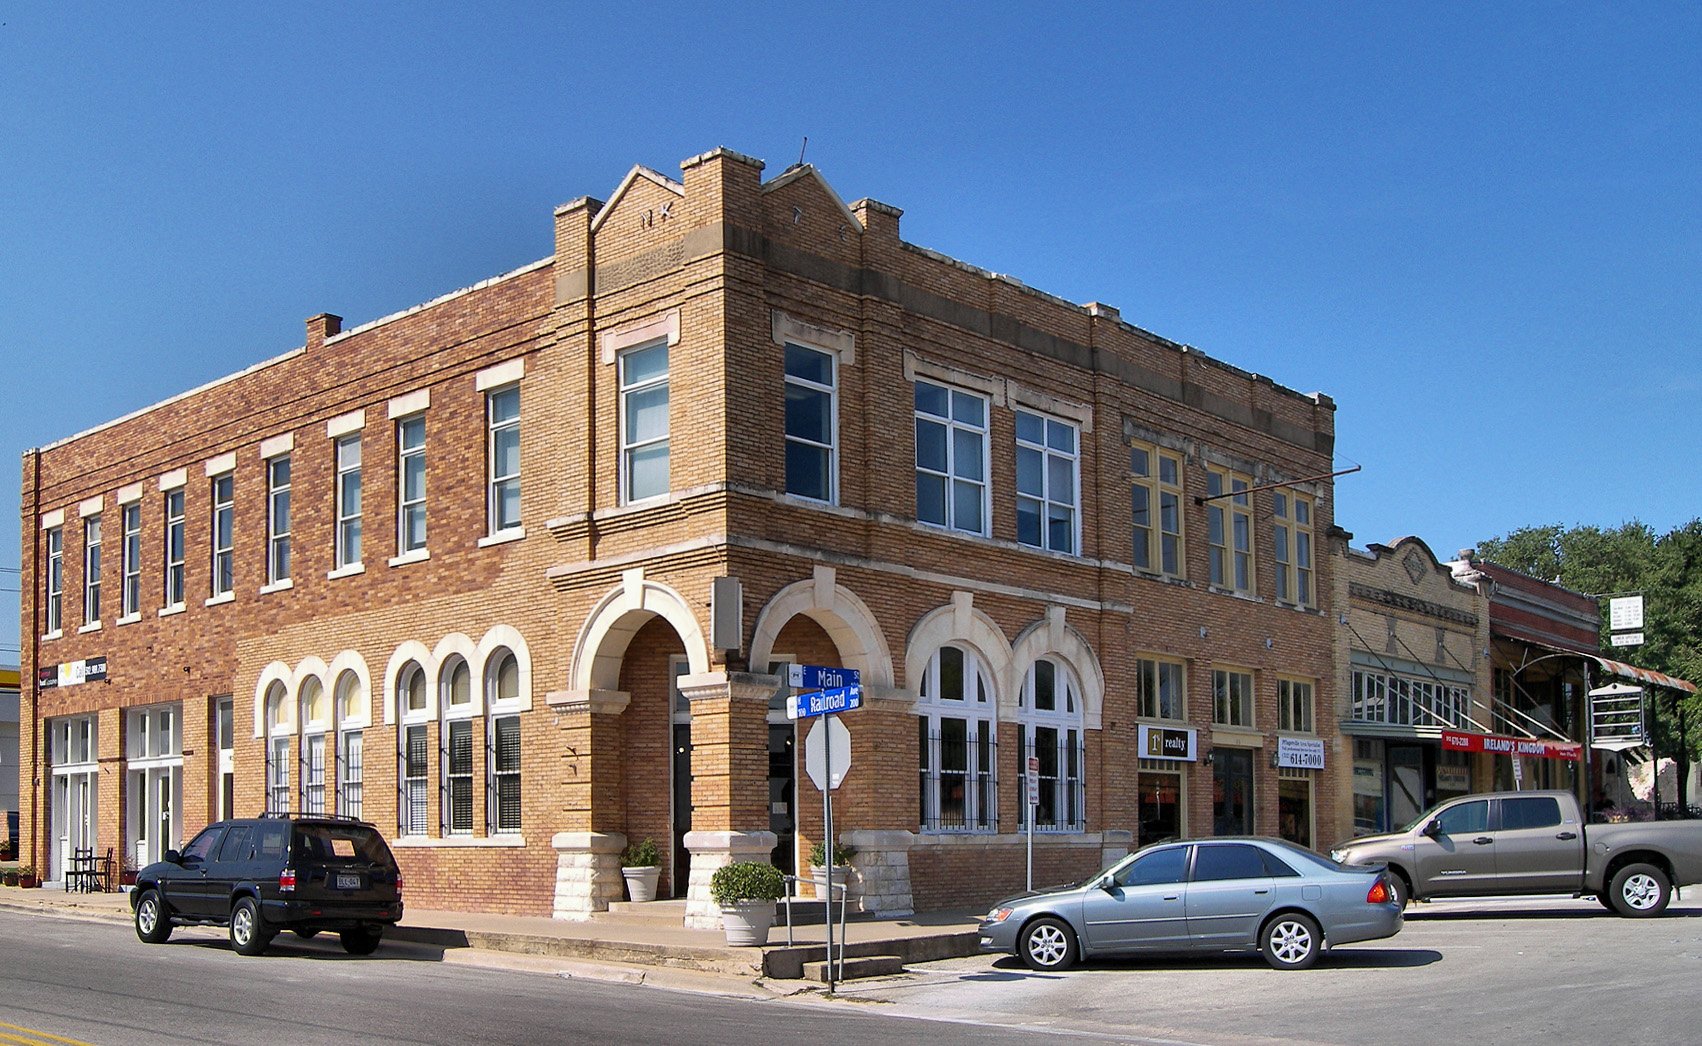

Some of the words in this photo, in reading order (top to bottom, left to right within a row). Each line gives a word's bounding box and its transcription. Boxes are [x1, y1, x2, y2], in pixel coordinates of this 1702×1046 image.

[817, 669, 843, 688] Main
[810, 690, 845, 713] Railroad
[850, 687, 859, 696] Ave
[850, 698, 859, 708] 200
[1165, 737, 1186, 751] realty
[1484, 738, 1515, 753] IRELAND'S
[1517, 741, 1545, 755] KINGDOM
[1290, 753, 1322, 766] 614-7000
